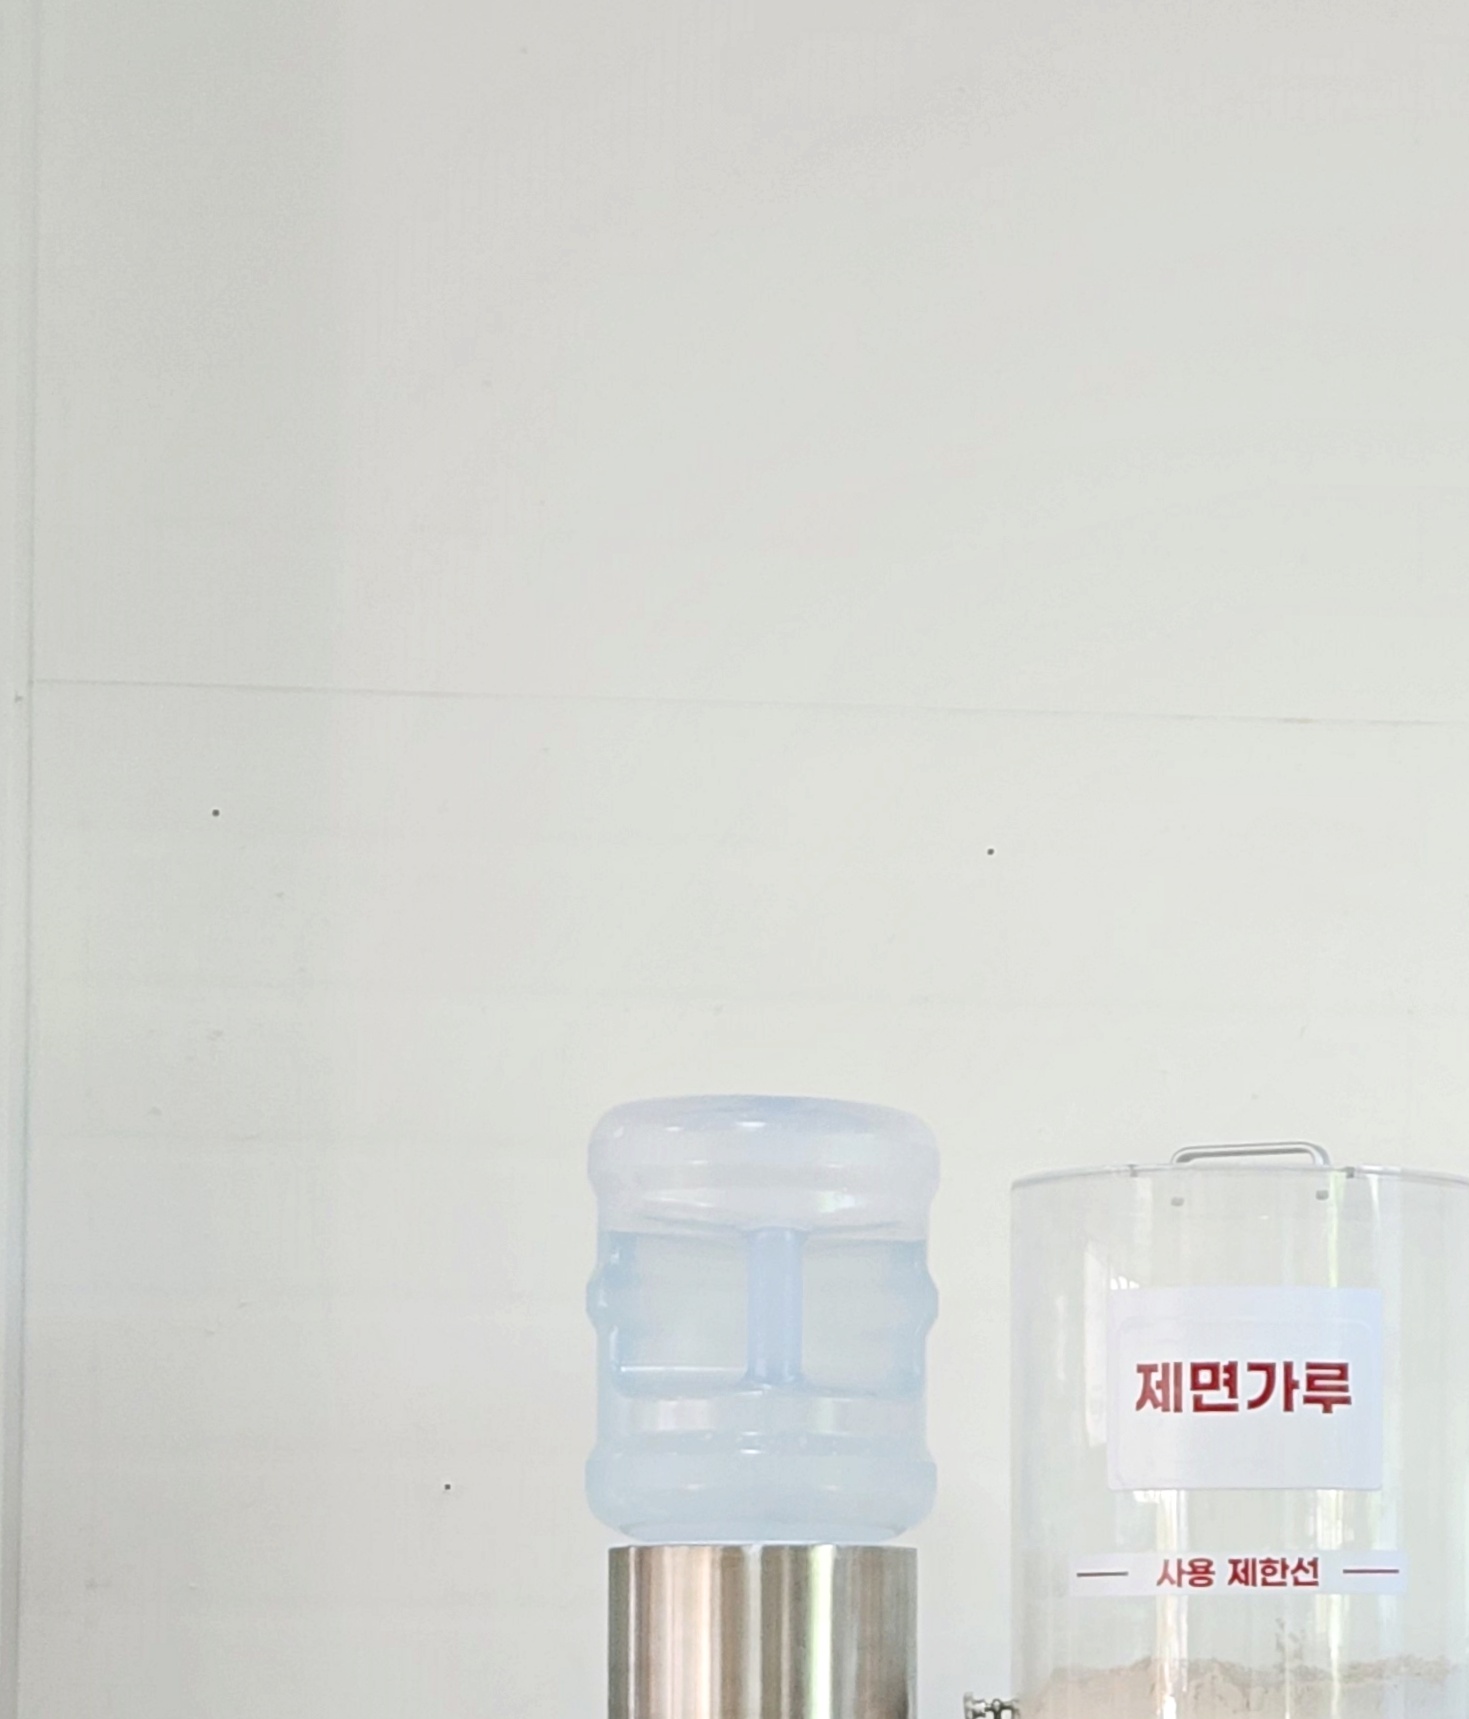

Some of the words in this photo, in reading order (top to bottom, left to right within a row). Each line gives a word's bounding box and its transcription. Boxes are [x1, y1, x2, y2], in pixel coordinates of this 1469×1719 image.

[1135, 1361, 1352, 1414] 제면가루
[1156, 1558, 1216, 1588] 사용
[1227, 1557, 1320, 1587] 제한선
